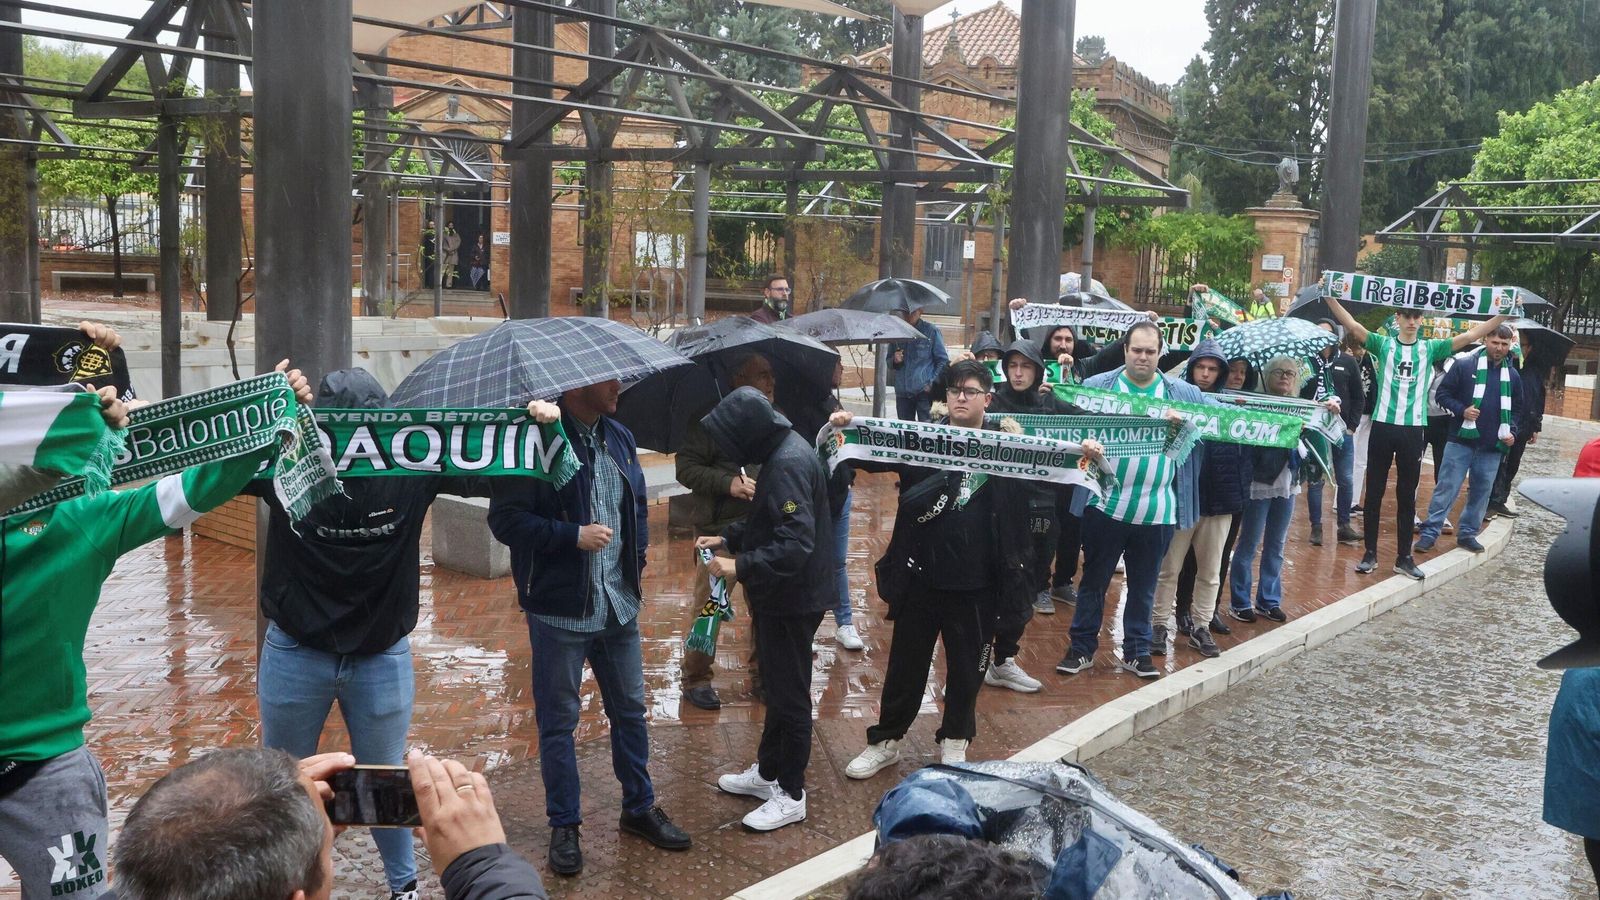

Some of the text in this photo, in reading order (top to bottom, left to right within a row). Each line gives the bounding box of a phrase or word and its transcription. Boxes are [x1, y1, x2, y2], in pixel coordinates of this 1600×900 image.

[316, 411, 509, 424] EYENDA BÉTICA
[1230, 418, 1281, 442] OJM
[262, 415, 564, 474] AQUÍN
[865, 420, 1059, 448] SI ME DAS A ELEGIR
[871, 449, 1050, 477] ME QUEDO CONTIGO
[917, 494, 949, 523] adidas
[50, 869, 104, 897] BOXEO
